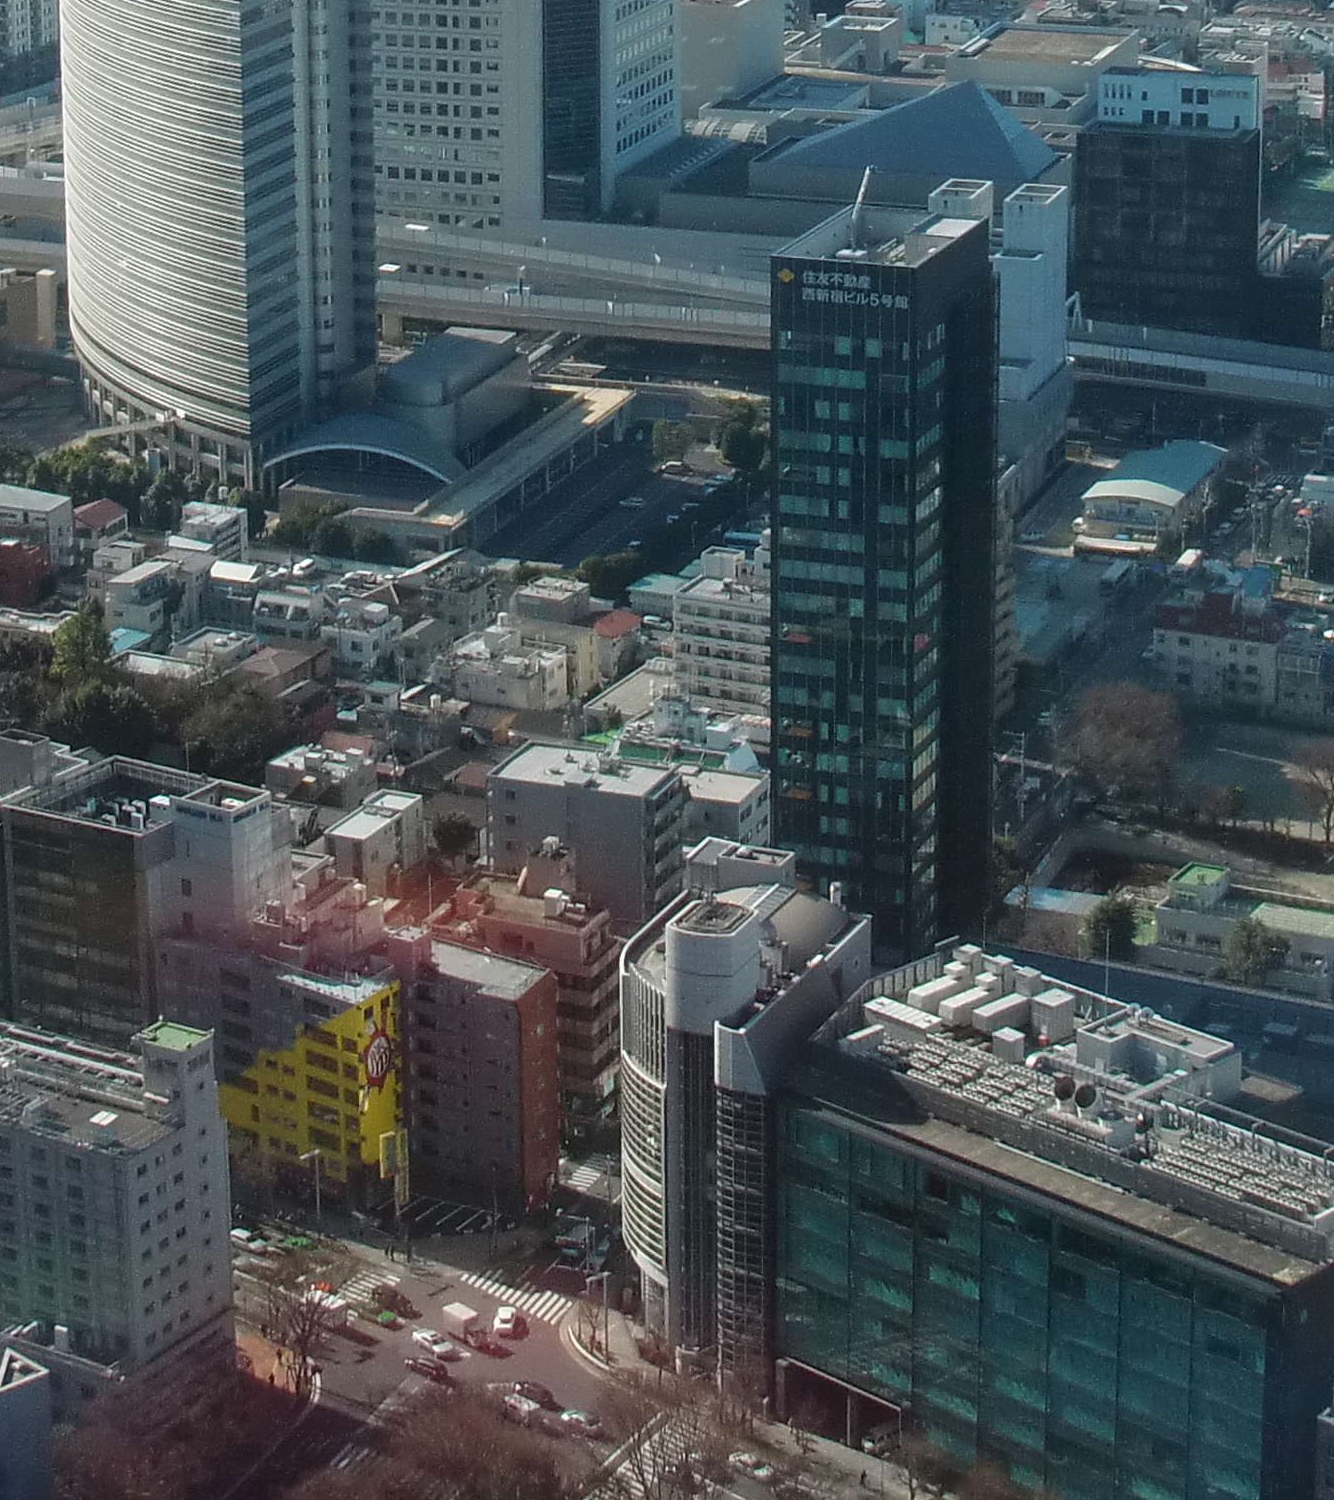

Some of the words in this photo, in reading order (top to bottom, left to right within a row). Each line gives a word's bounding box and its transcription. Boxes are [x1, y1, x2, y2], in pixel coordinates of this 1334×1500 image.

[802, 270, 871, 289] 住友不動産
